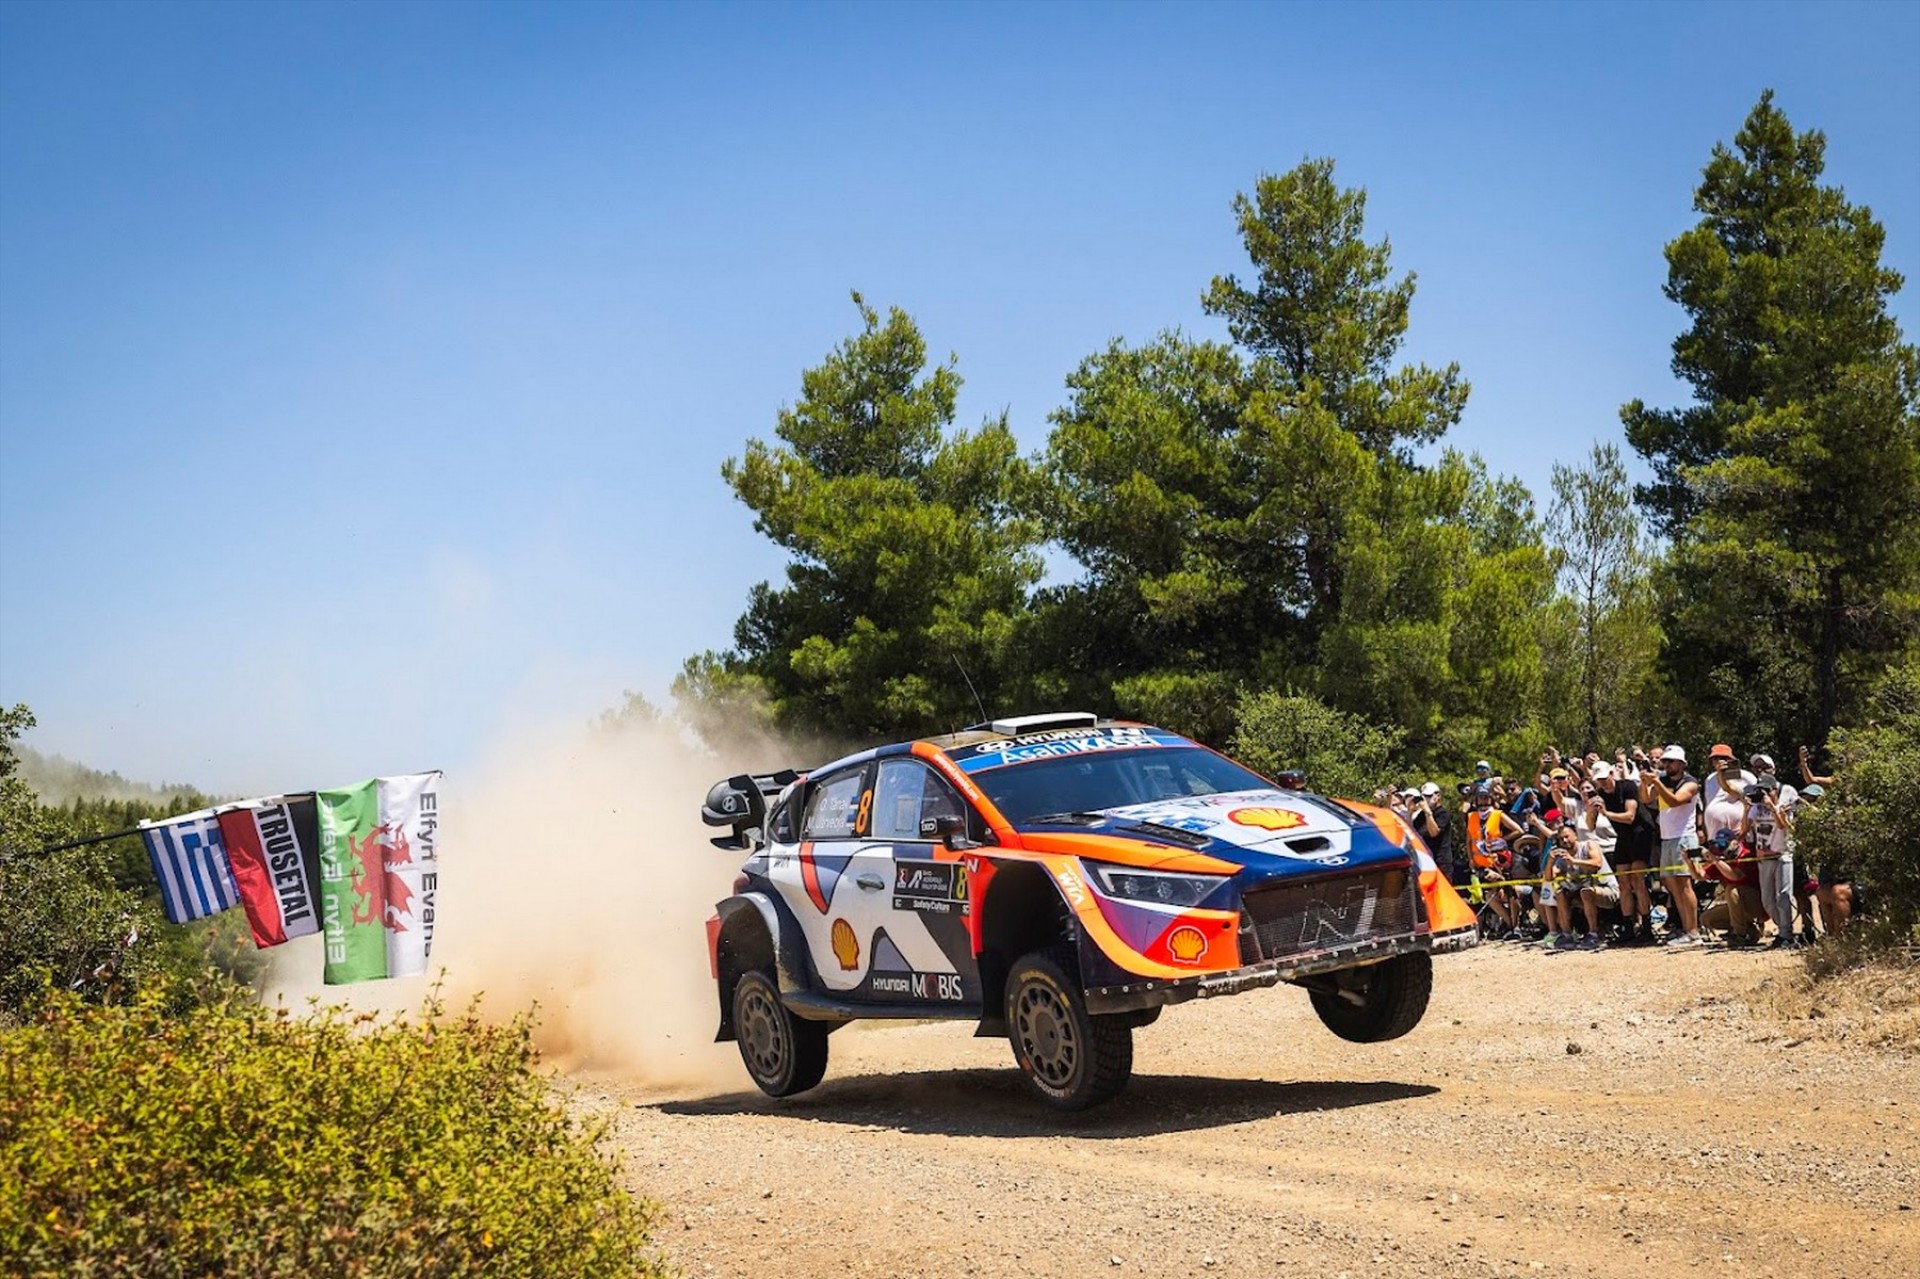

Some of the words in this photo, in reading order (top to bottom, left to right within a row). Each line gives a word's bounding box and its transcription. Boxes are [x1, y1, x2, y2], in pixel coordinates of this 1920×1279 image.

[1001, 735, 1162, 764] AsahiKASEI
[1017, 729, 1104, 746] HYUNDAI
[417, 792, 437, 861] Elfyn
[855, 789, 873, 834] 8
[257, 804, 310, 927] TRUSETAL
[966, 859, 979, 874] N
[956, 866, 967, 900] 8
[873, 978, 910, 992] HYUNDAI
[912, 973, 964, 1001] MOBIS
